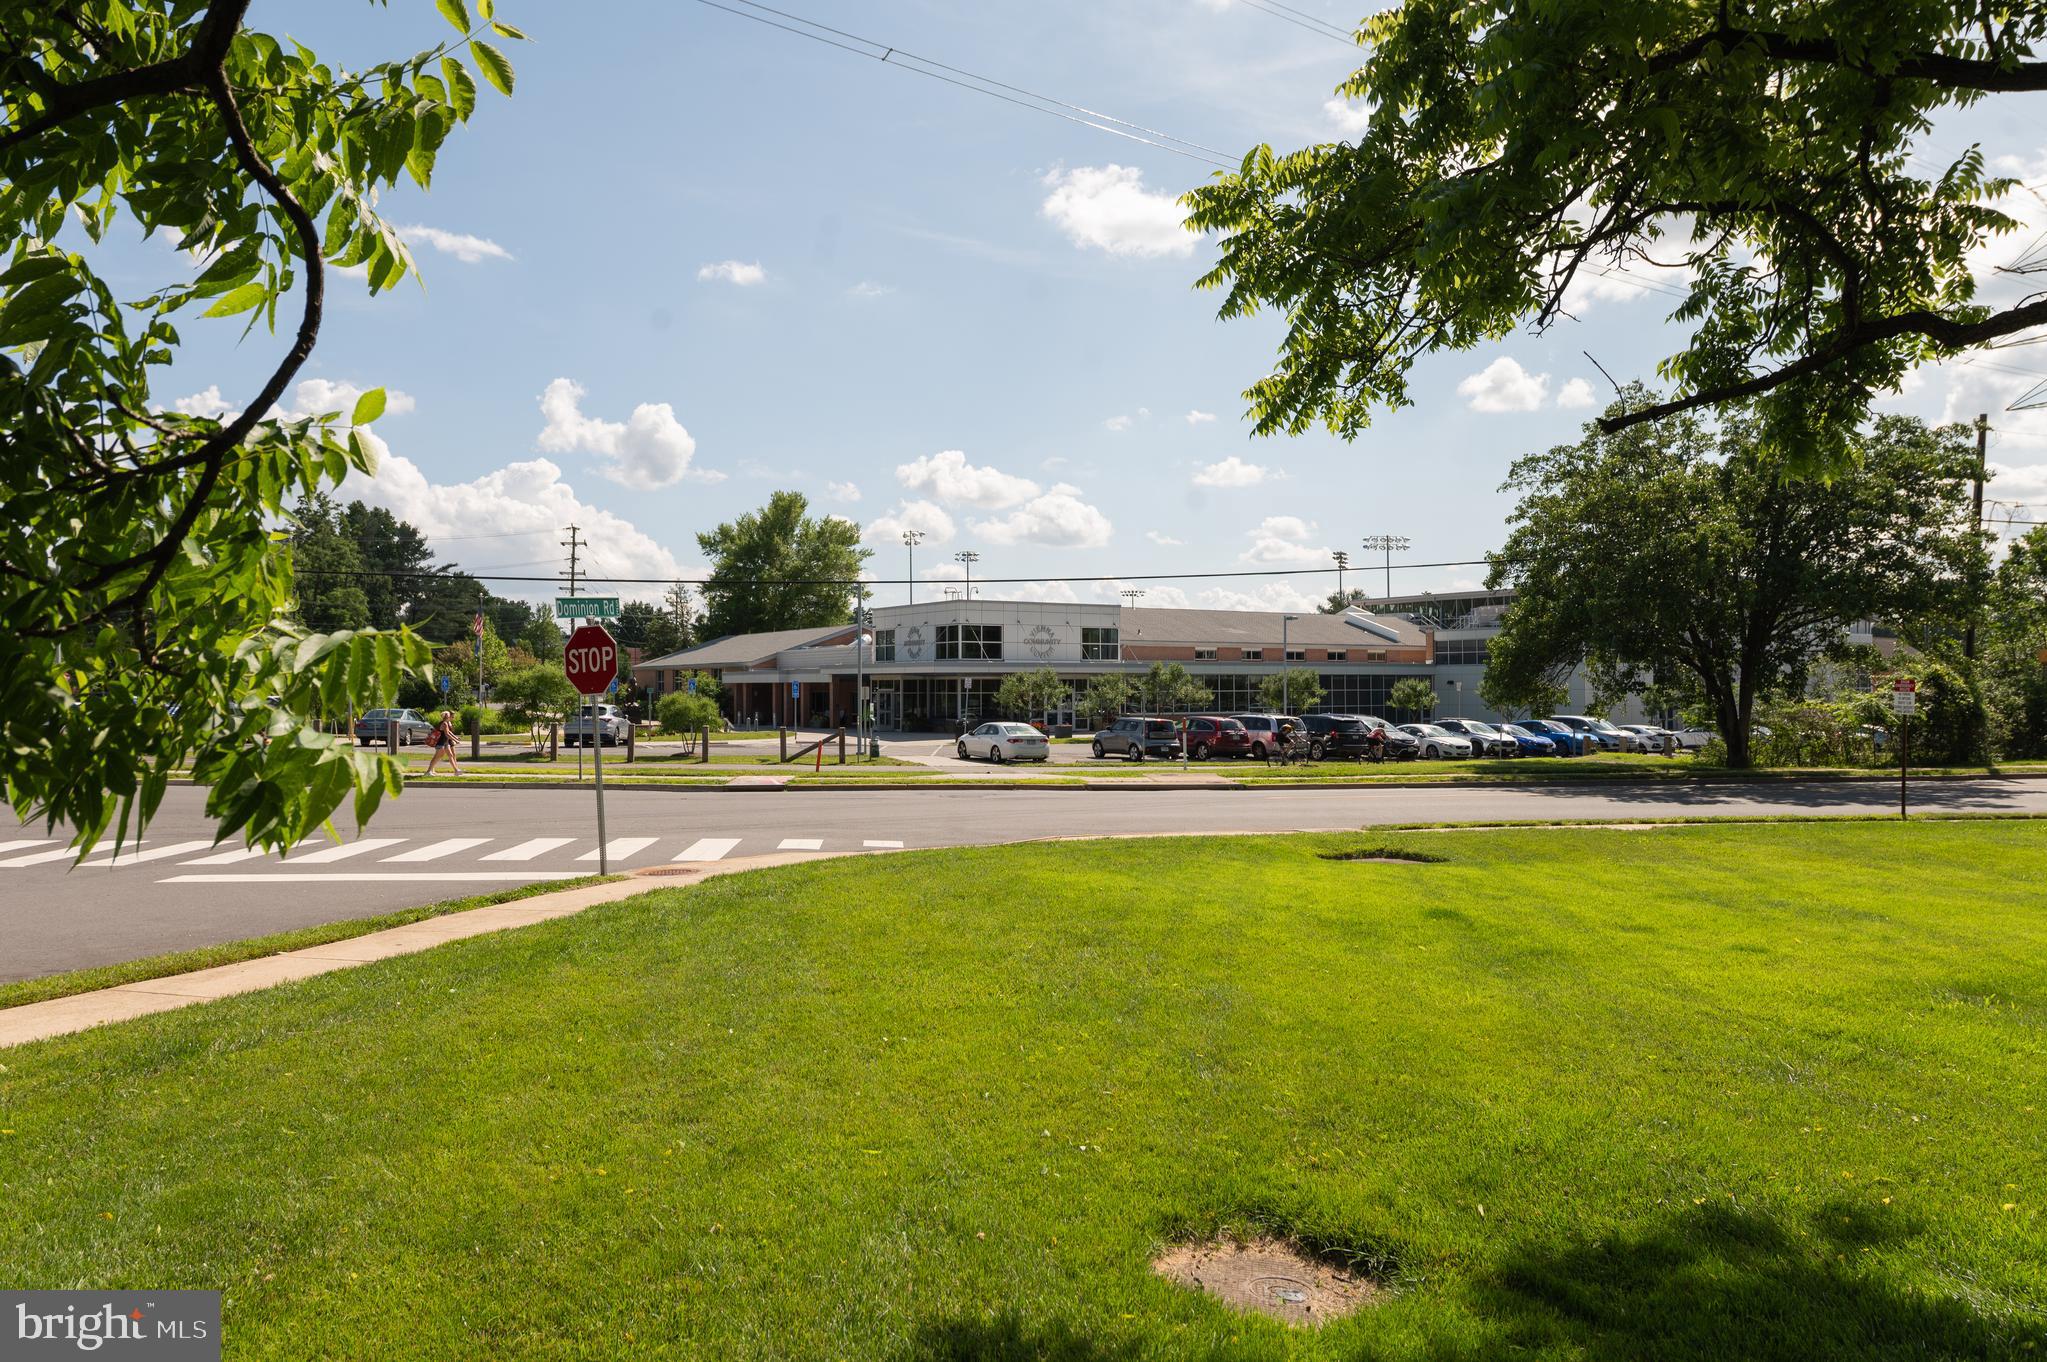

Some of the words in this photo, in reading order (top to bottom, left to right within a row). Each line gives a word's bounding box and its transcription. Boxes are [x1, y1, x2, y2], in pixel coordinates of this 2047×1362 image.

[557, 600, 600, 616] Dominion
[603, 600, 615, 615] Rd
[568, 646, 613, 674] STOP
